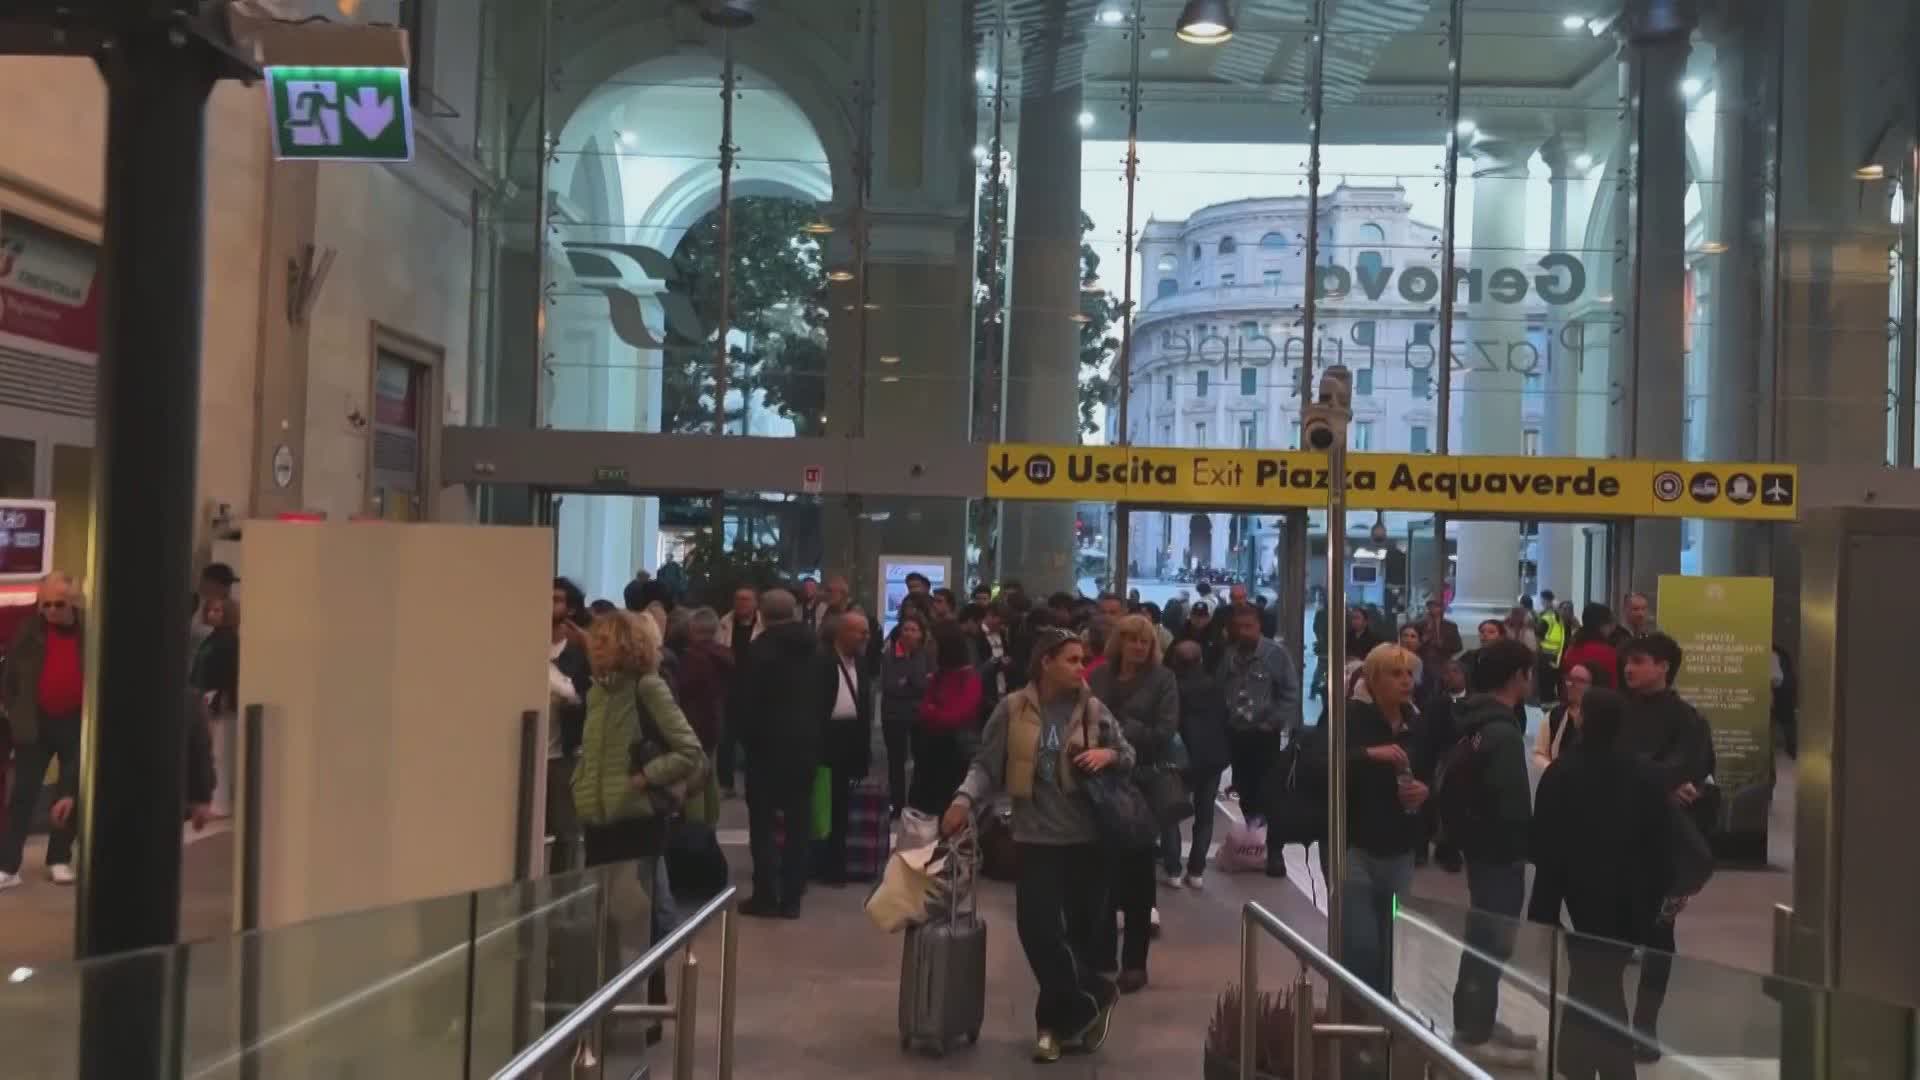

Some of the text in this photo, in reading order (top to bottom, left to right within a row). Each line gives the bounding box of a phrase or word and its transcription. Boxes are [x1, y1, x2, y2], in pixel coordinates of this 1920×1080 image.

[1068, 454, 1177, 485] Uscita
[1193, 458, 1244, 487] Exit
[1388, 463, 1620, 499] Acquaverde
